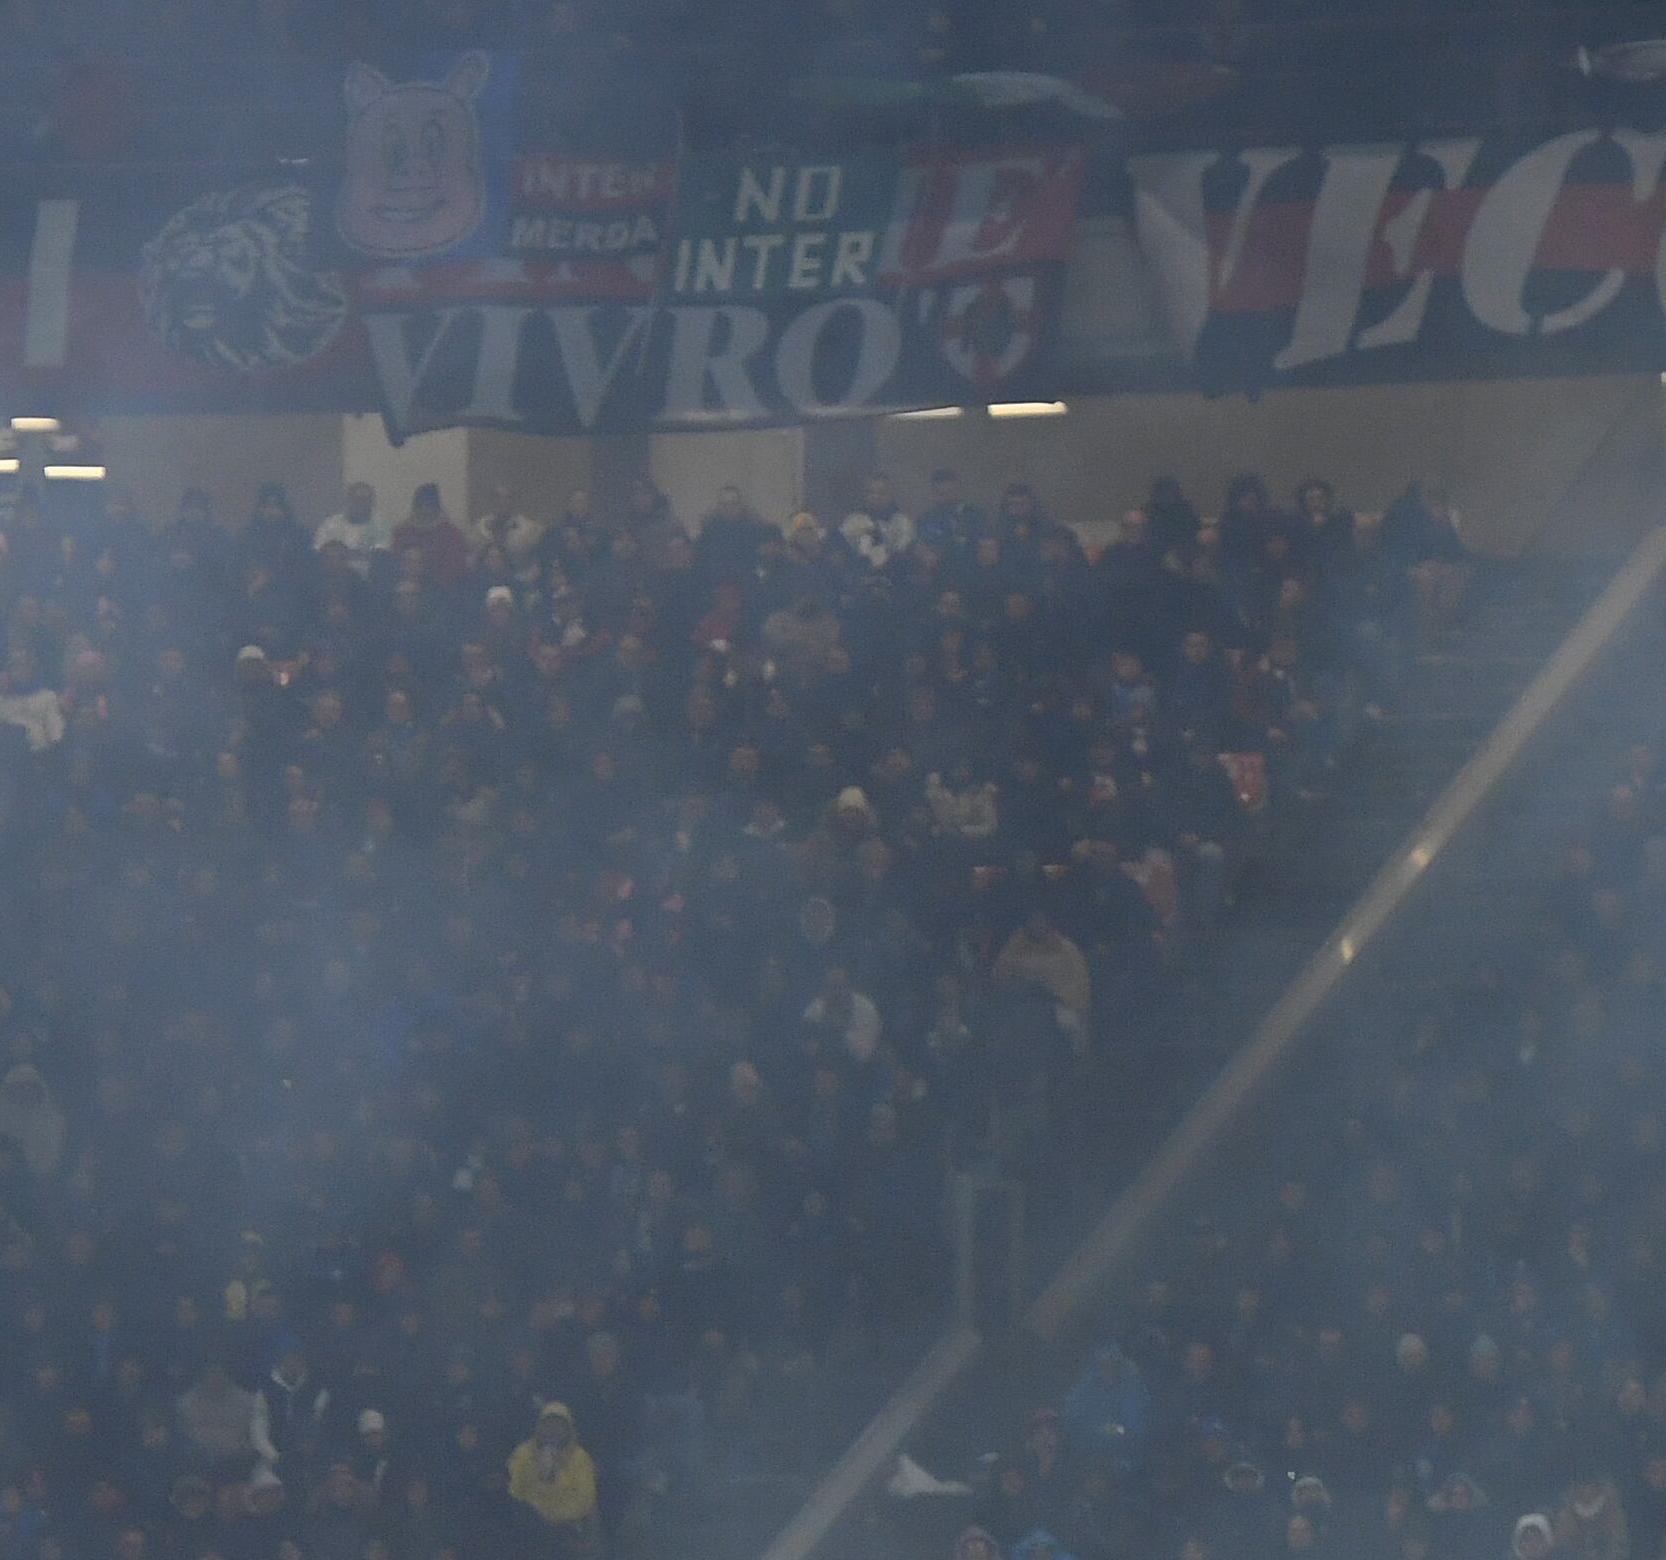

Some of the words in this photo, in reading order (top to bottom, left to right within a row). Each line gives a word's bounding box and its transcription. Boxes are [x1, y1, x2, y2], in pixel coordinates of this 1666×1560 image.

[734, 164, 845, 224] NO
[511, 211, 662, 252] MERDA
[674, 229, 878, 296] INTER
